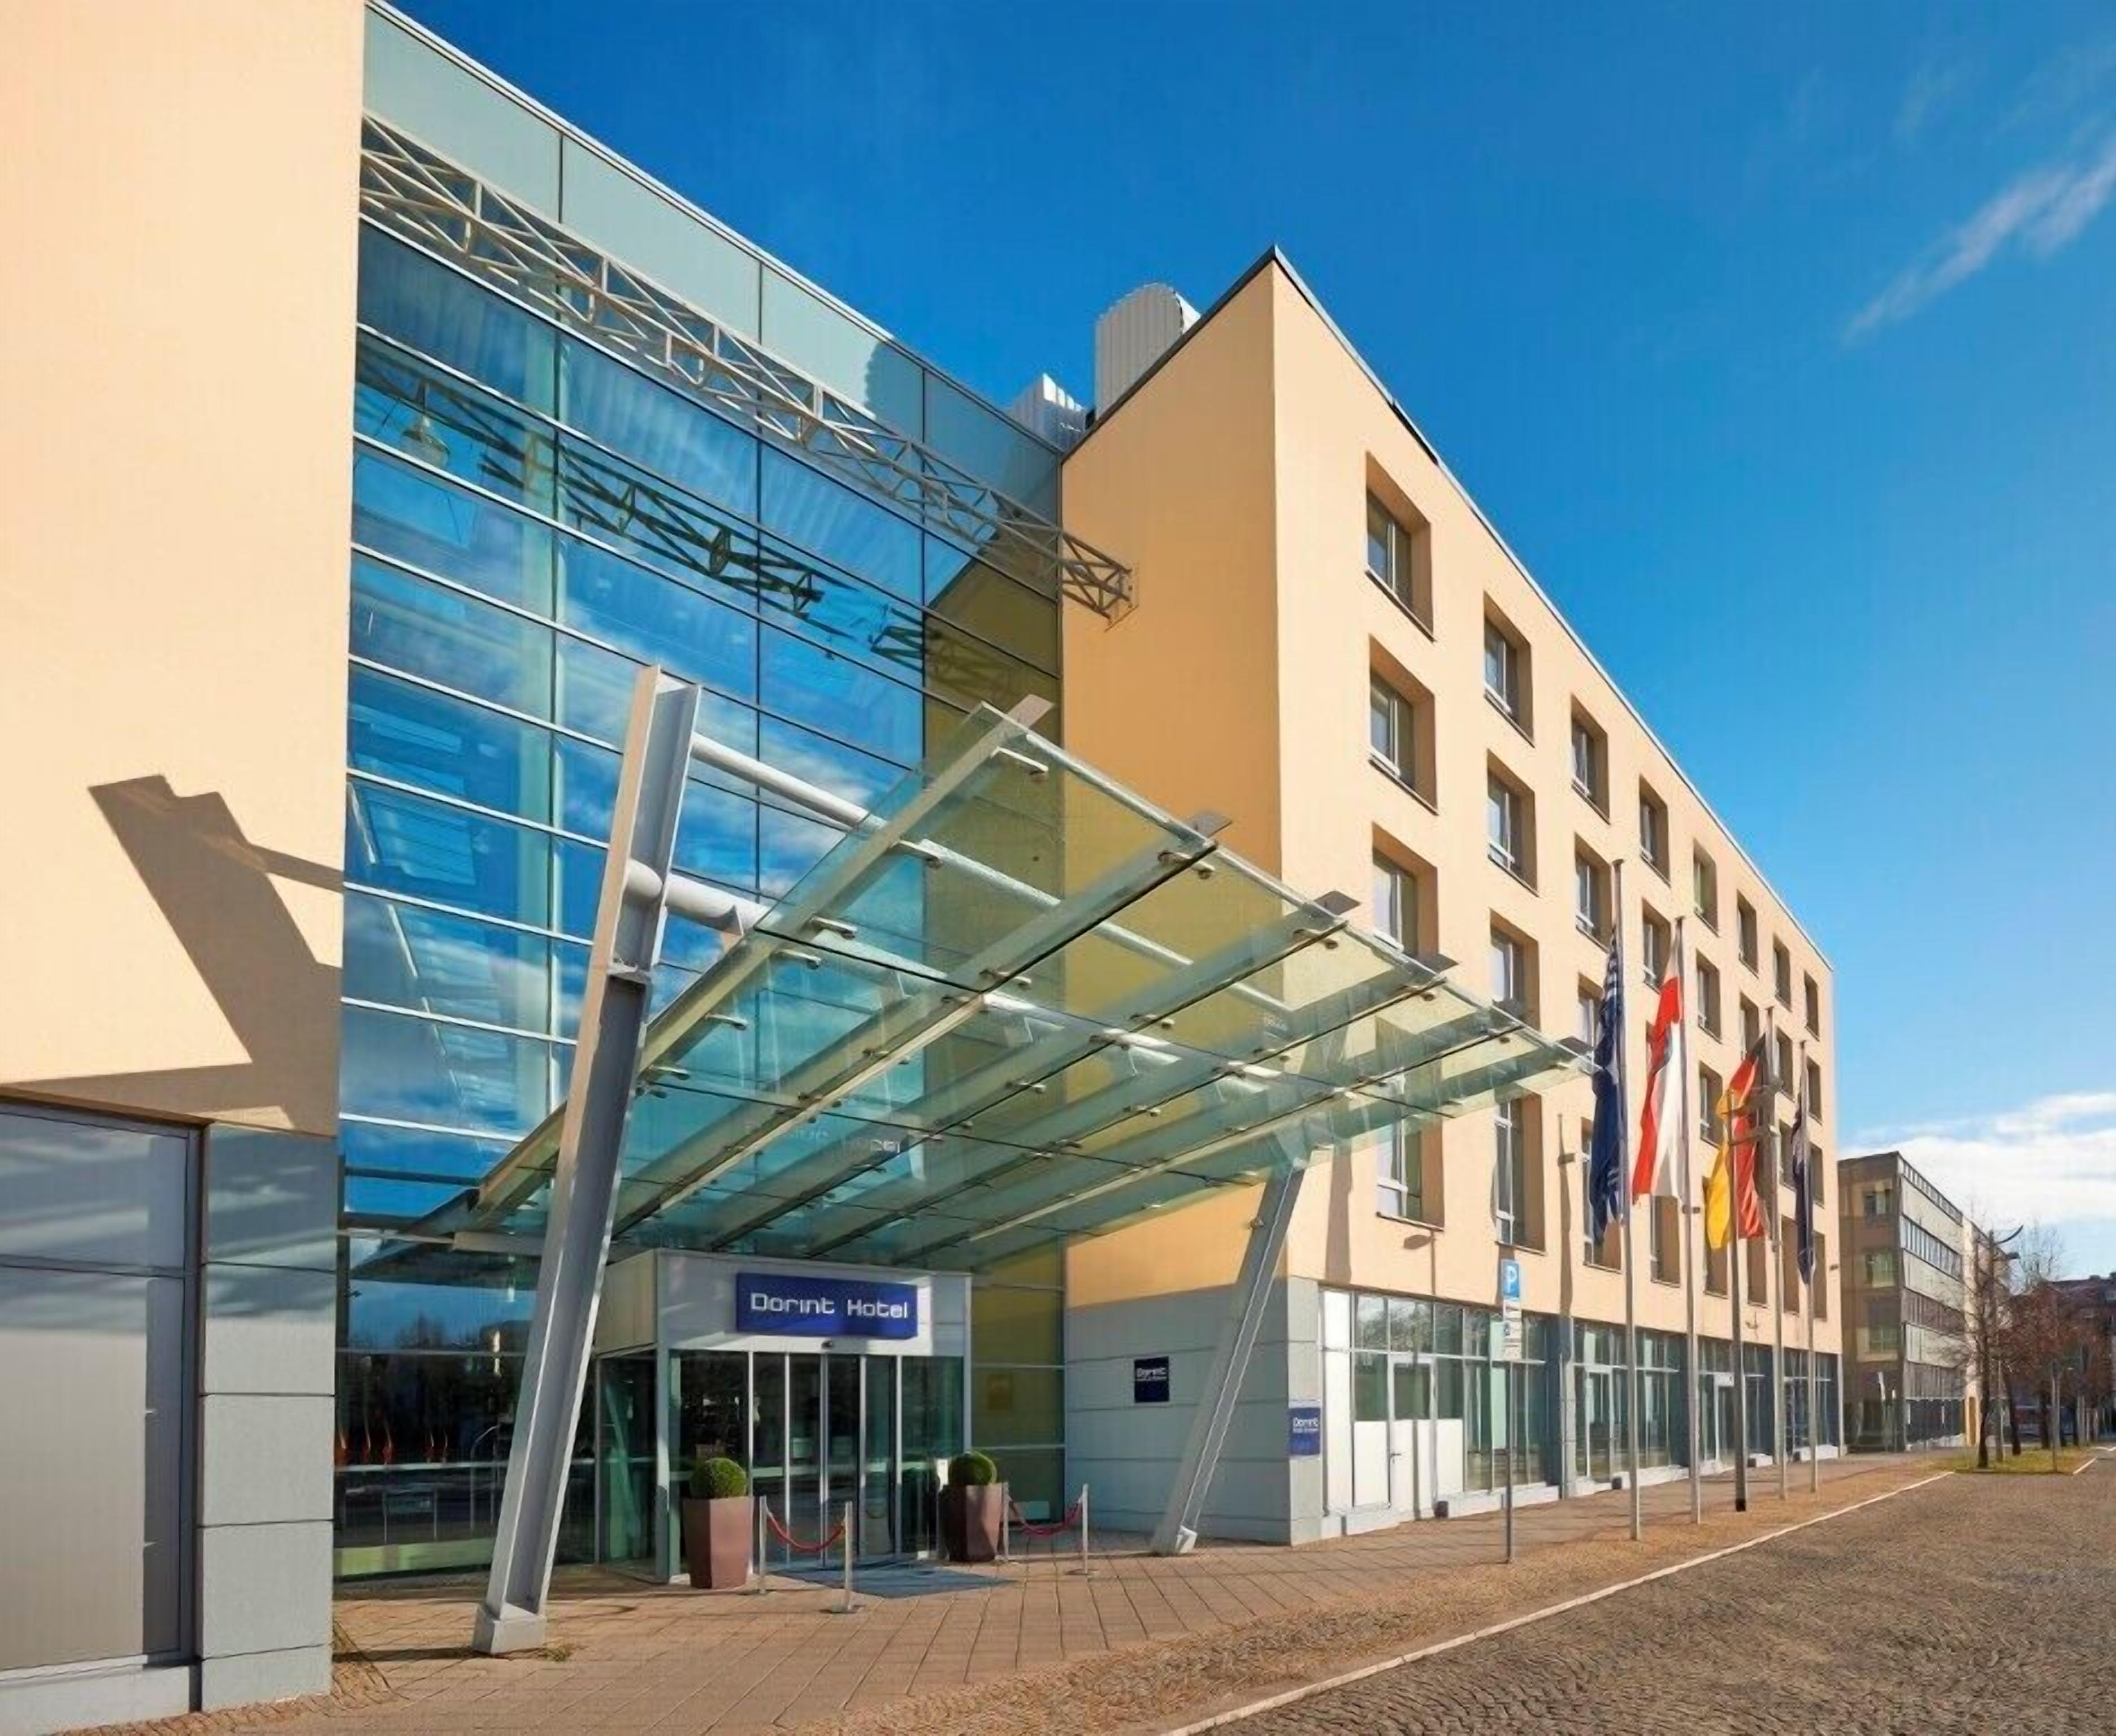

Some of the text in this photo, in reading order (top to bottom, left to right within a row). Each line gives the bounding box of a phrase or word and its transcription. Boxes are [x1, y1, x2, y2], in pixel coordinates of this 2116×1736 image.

[1507, 1265, 1517, 1292] P
[751, 1292, 908, 1318] Dorint Hotel
